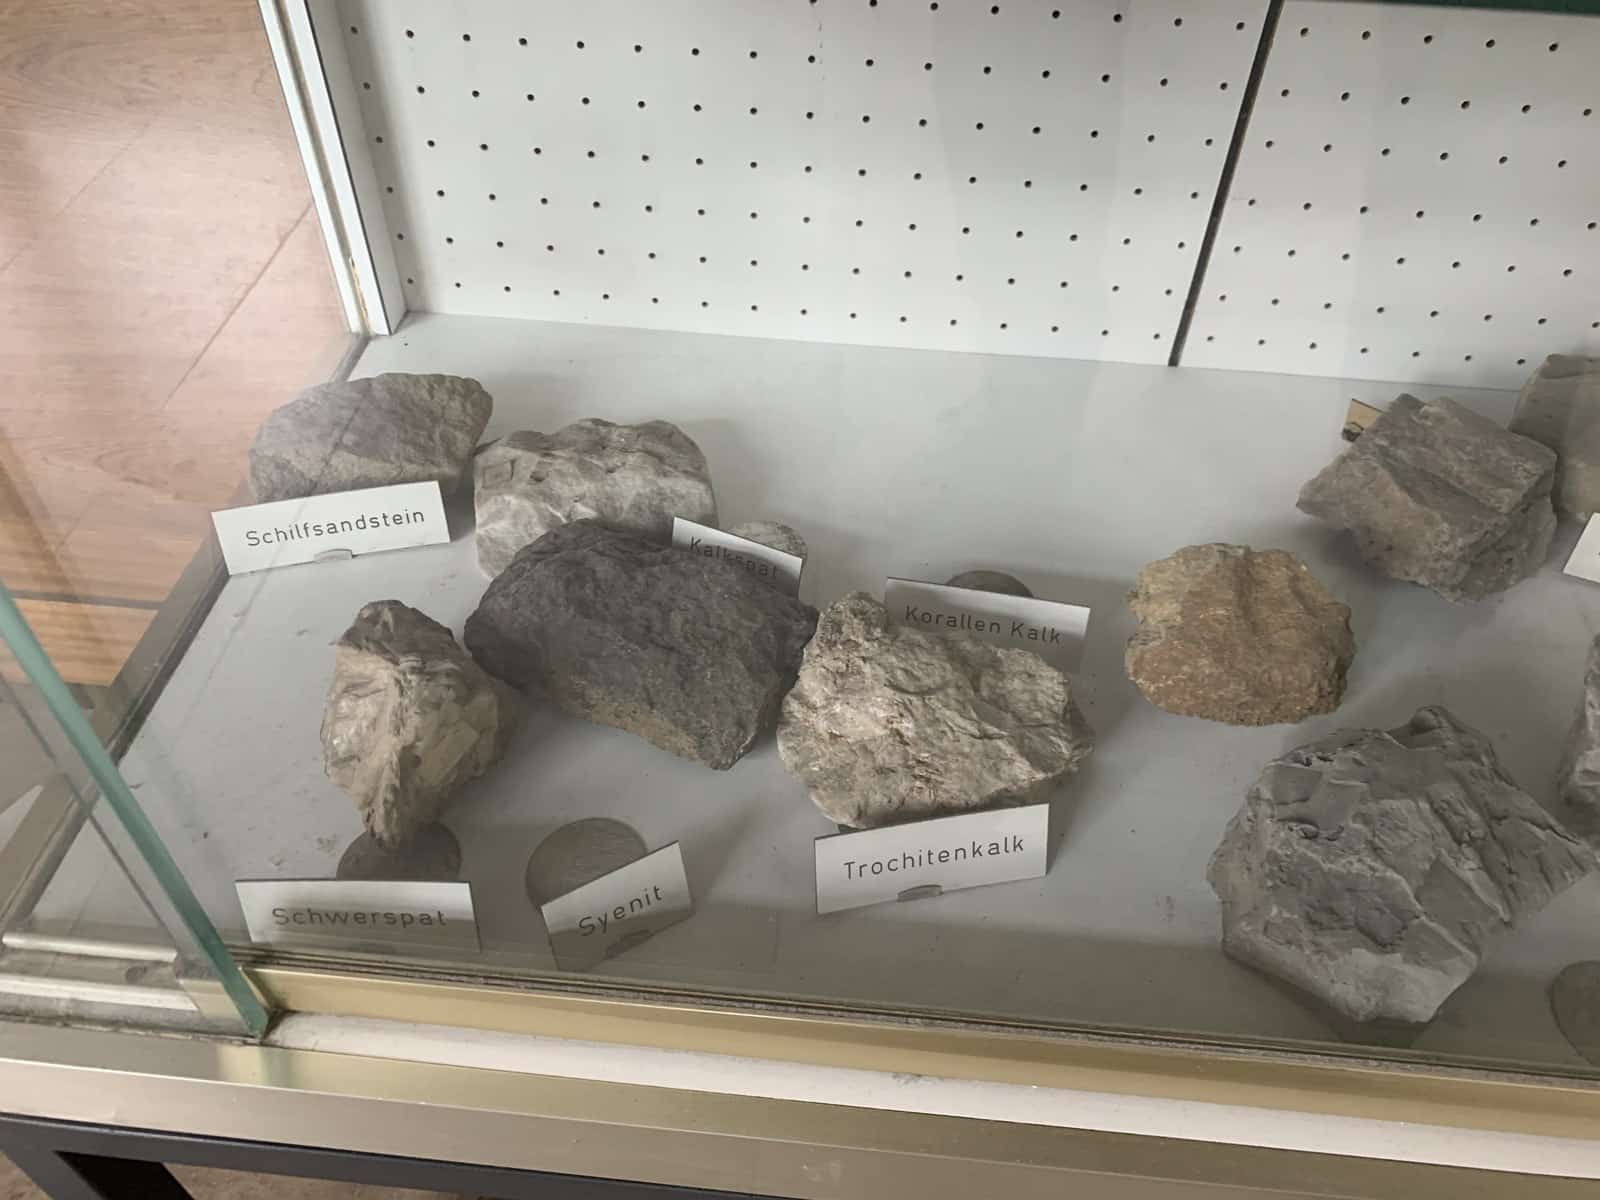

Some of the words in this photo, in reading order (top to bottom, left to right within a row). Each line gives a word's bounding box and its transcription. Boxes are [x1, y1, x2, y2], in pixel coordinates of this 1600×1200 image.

[246, 508, 426, 547] Schilfsandstein
[904, 605, 1001, 634] Korallen
[1010, 621, 1061, 644] Kalk
[843, 835, 1025, 880] Trochitenkalk
[271, 907, 447, 929] Schwerspat
[578, 885, 664, 937] Syenit
